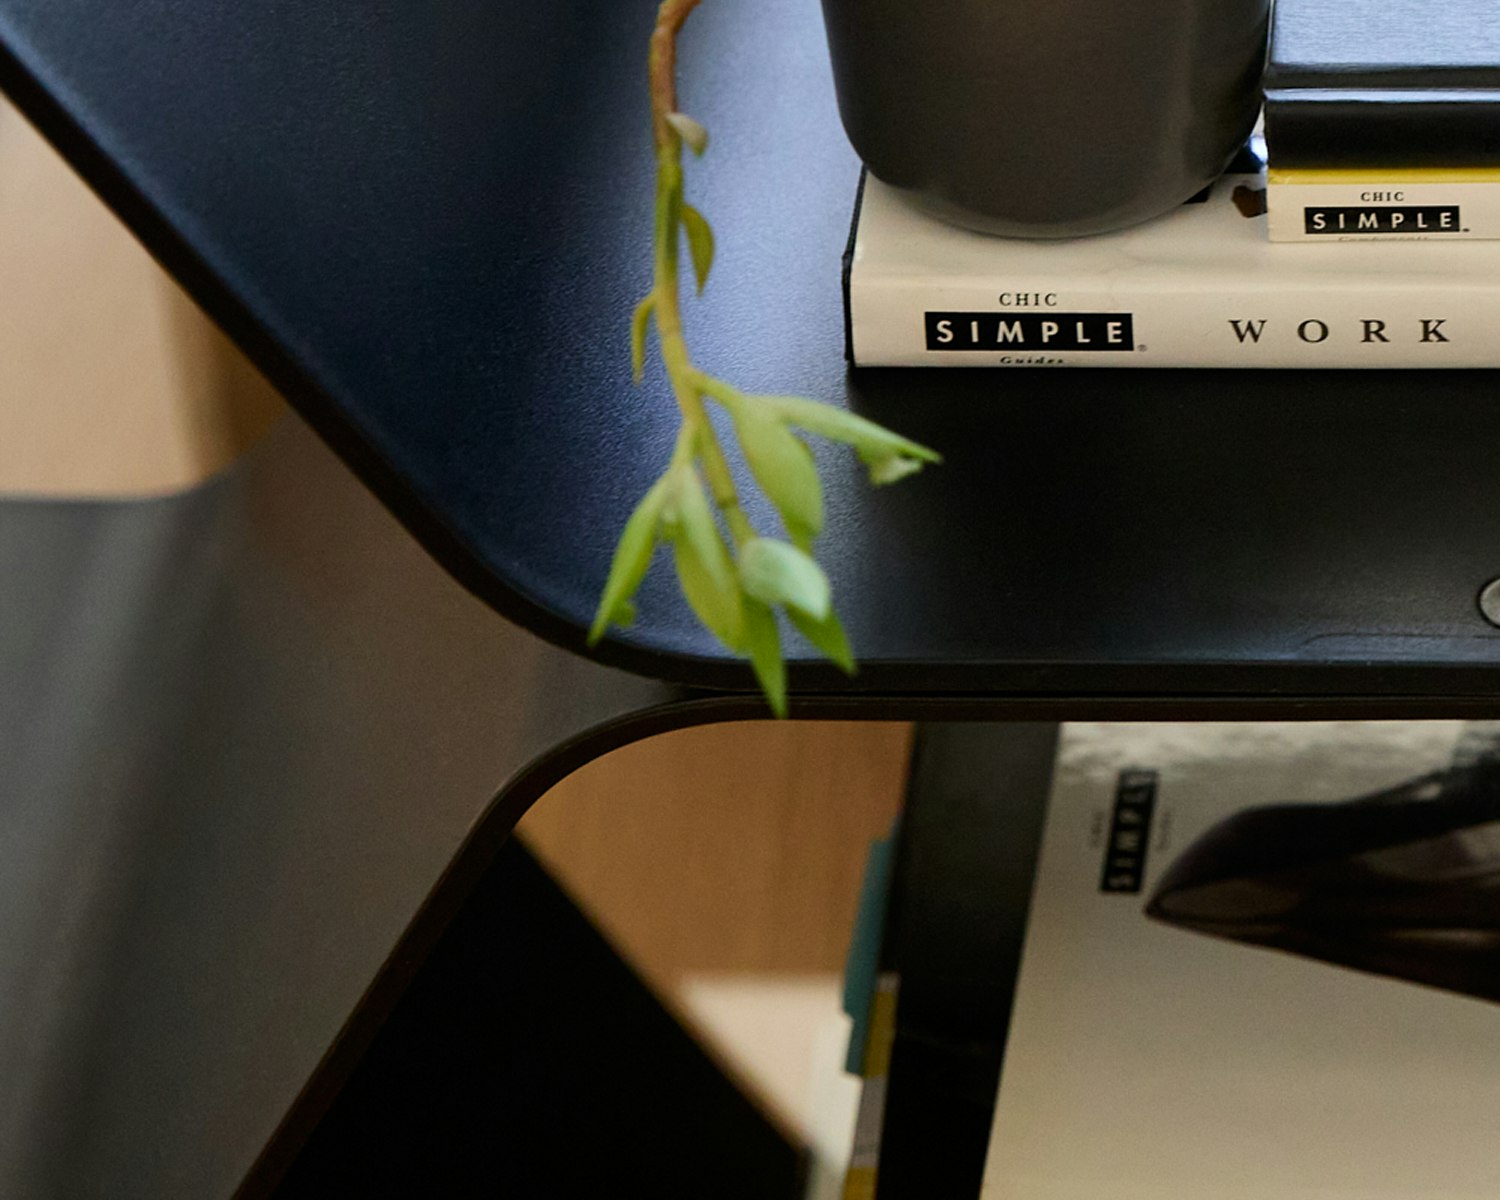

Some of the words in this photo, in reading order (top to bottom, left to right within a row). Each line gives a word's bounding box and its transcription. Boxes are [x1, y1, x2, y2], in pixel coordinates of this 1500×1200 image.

[1360, 191, 1405, 202] CHIC
[1312, 211, 1453, 230] SIMPLE
[998, 291, 1059, 307] CHIC
[935, 318, 1124, 344] SIMPLE
[1227, 318, 1451, 344] WORK
[999, 355, 1065, 365] Guides
